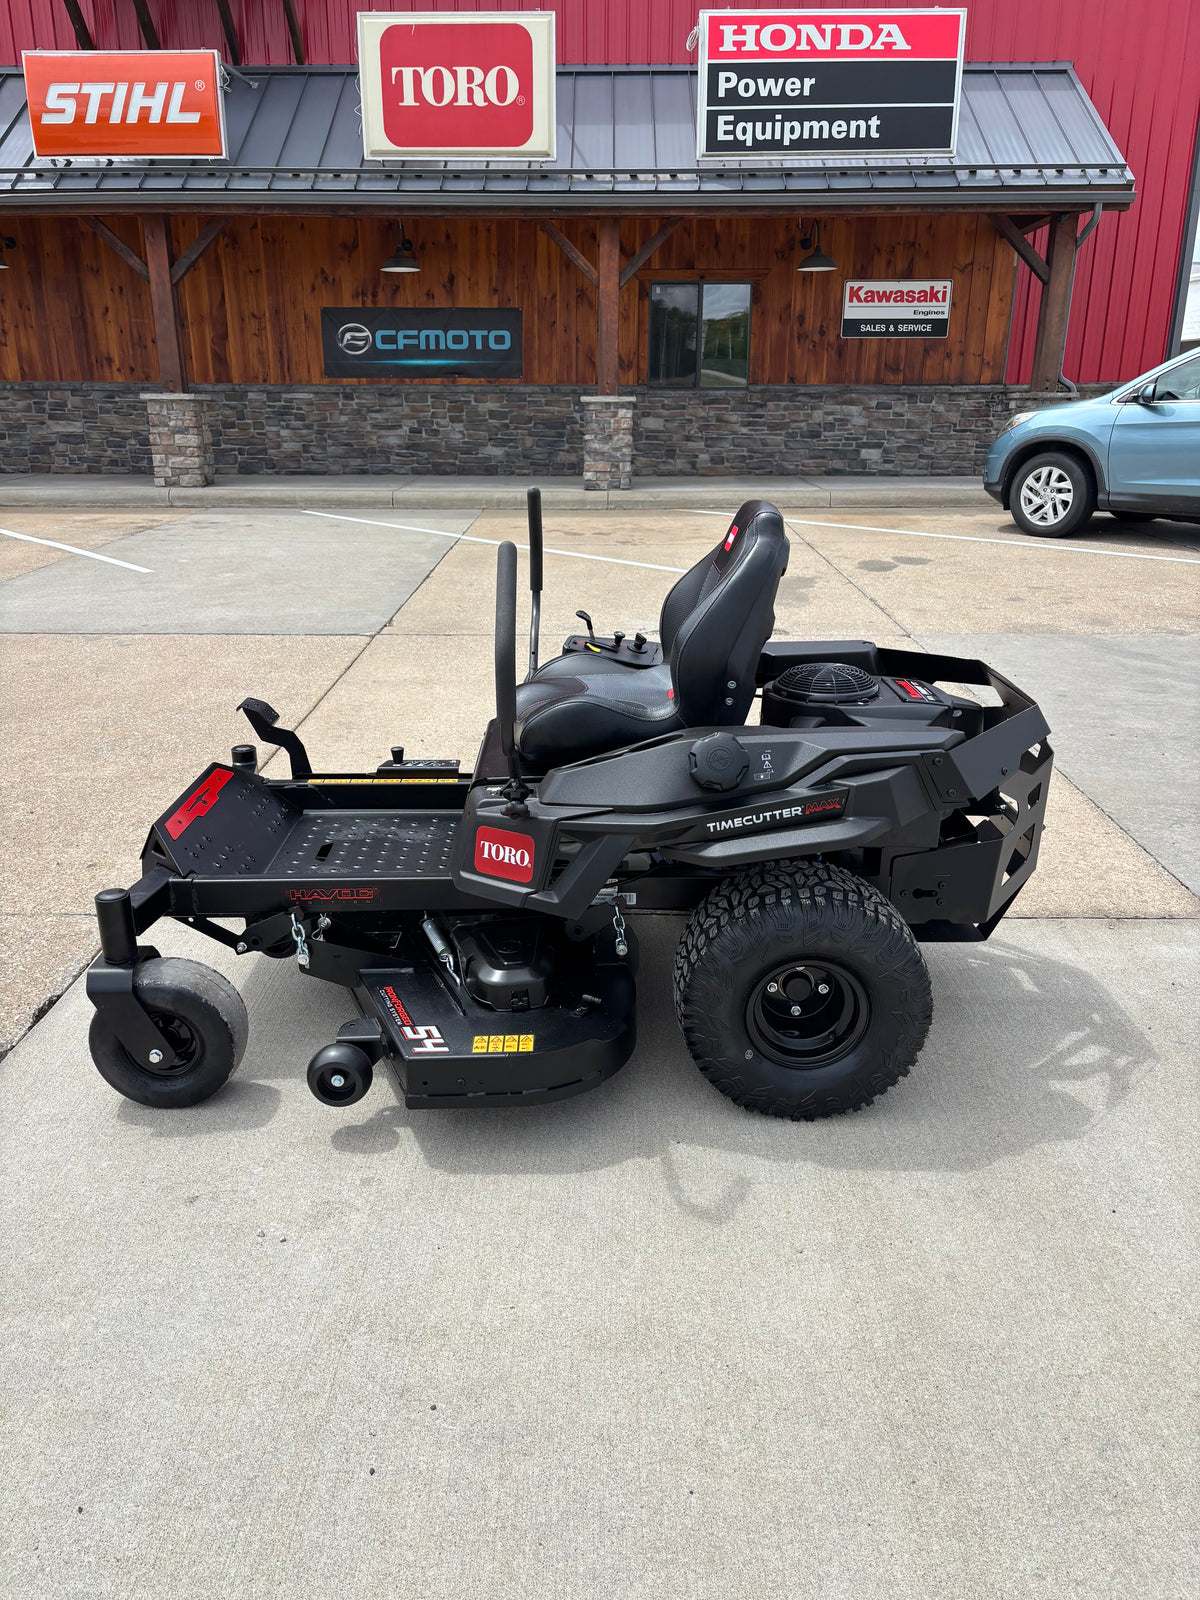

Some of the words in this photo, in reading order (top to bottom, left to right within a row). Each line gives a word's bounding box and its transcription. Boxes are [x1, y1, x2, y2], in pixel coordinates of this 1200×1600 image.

[718, 24, 912, 51] HONDA
[391, 65, 520, 107] TORO
[717, 71, 816, 98] Power
[41, 82, 201, 125] STIHL
[716, 114, 881, 147] Equipment
[848, 285, 948, 304] Kawasaki
[913, 309, 946, 317] Engines
[375, 329, 512, 350] CFMOTO
[860, 324, 886, 332] SALES
[888, 324, 895, 332] &
[897, 324, 933, 332] SERVICE
[706, 806, 803, 833] TIMECUTTER
[804, 797, 842, 815] MAX
[480, 840, 531, 867] TORO
[289, 888, 375, 901] HAVOC
[399, 1025, 450, 1054] 54
